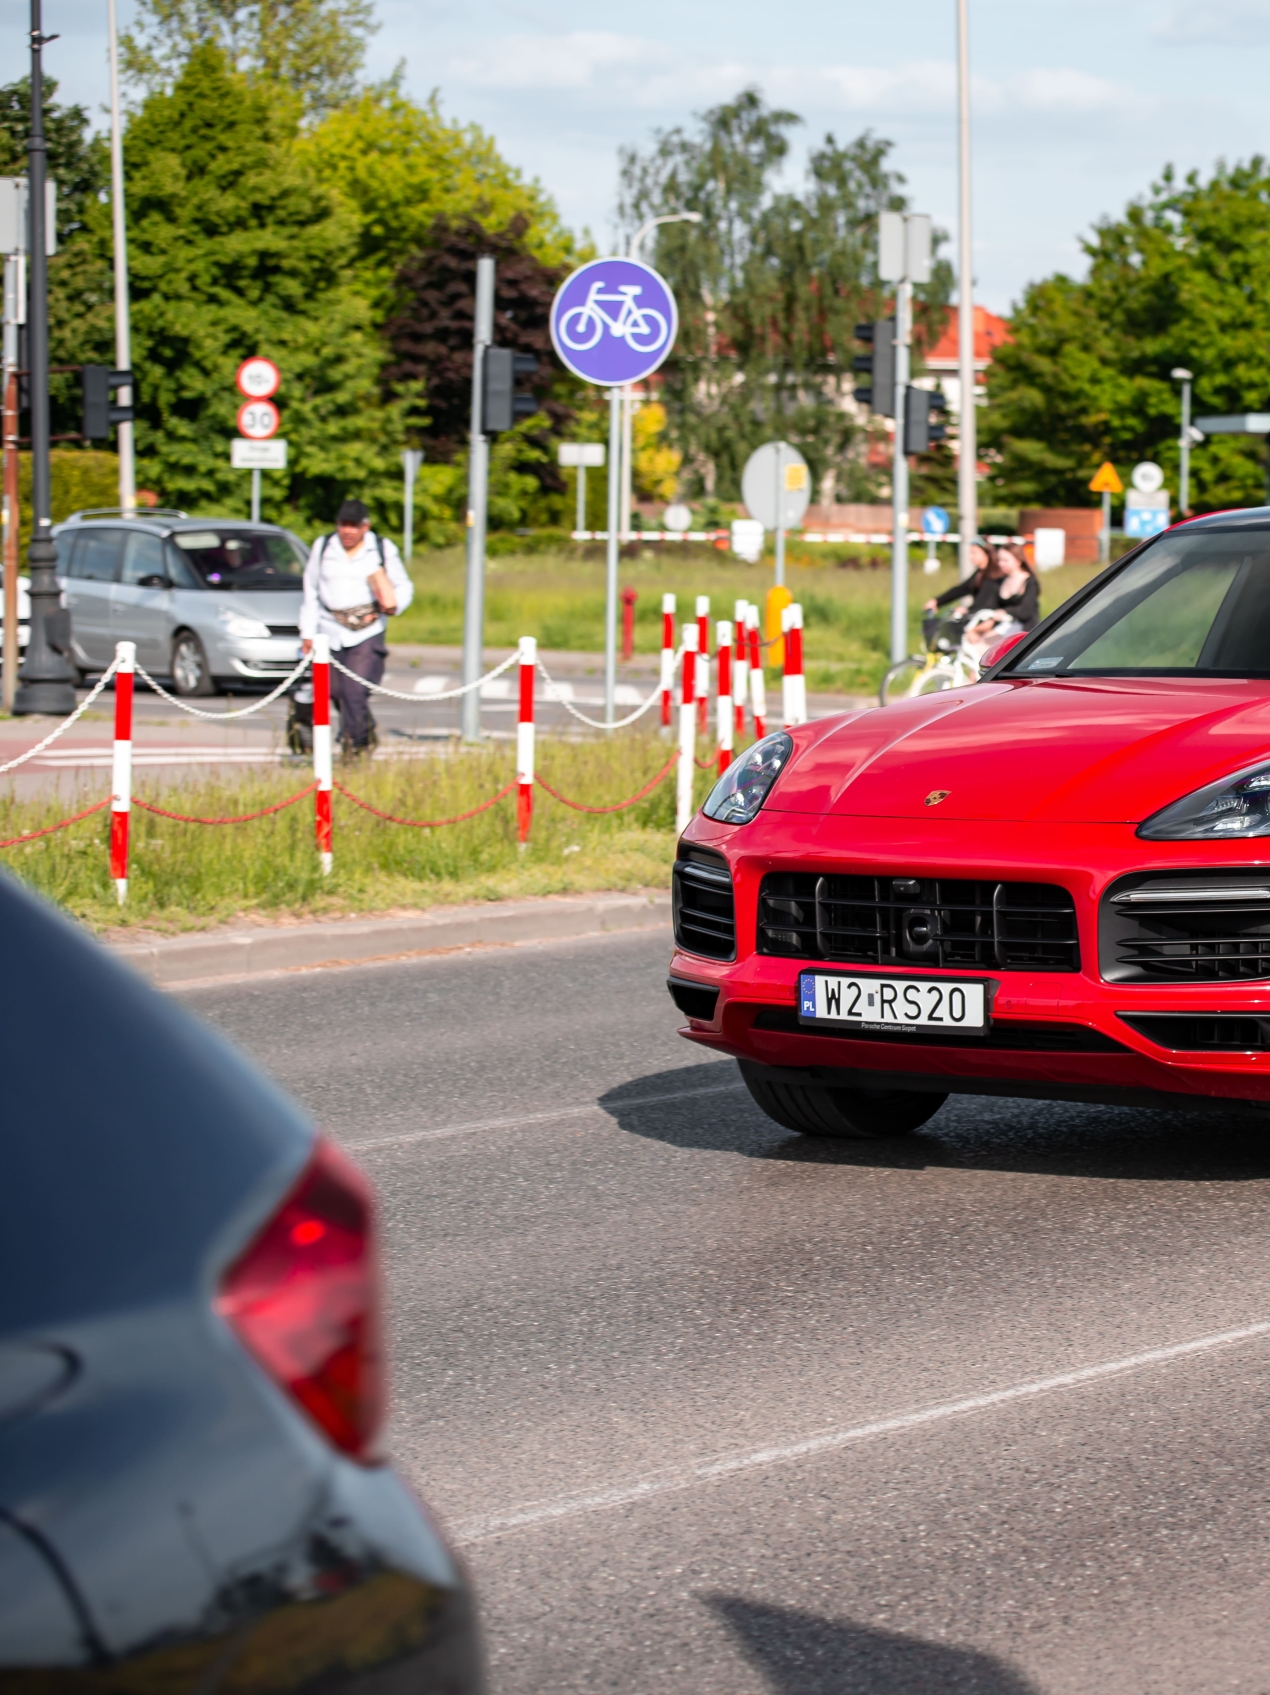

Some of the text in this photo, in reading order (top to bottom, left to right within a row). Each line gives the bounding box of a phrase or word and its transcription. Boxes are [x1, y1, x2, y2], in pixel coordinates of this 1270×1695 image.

[244, 411, 273, 430] 30
[803, 1000, 815, 1012] PL
[824, 979, 967, 1023] W2 RS20
[861, 1022, 917, 1033] Porsche Centrum Sopot
